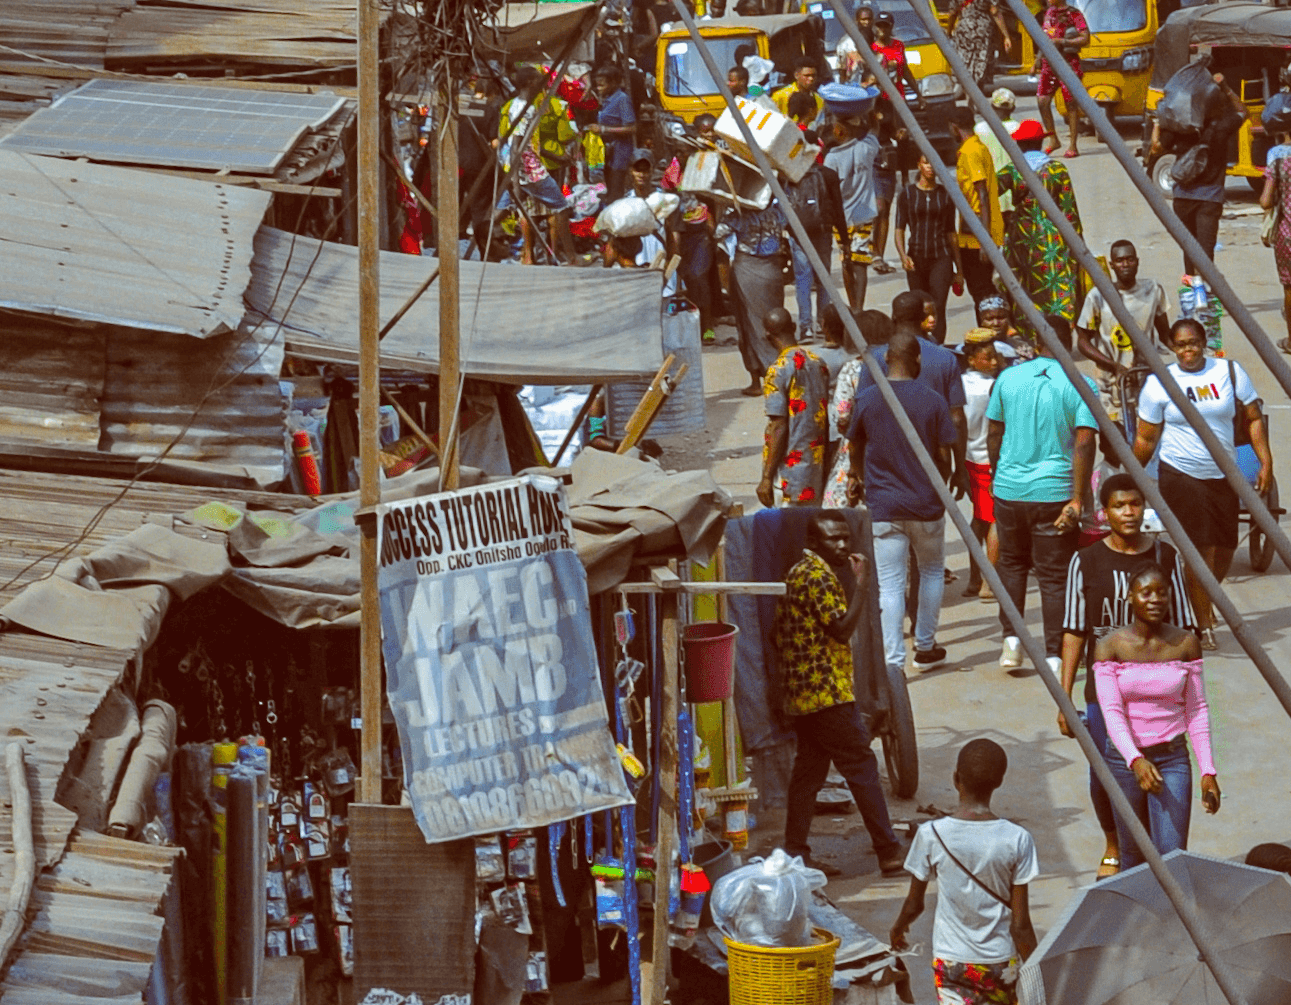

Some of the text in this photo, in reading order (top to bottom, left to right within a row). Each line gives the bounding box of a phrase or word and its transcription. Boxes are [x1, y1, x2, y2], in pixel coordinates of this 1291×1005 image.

[440, 486, 528, 550] TUTORIAL
[448, 553, 473, 570] CKC
[476, 546, 521, 565] Onitsha
[389, 561, 558, 652] WAEC
[404, 633, 567, 727] JAMB
[424, 708, 536, 758] LECTURES
[412, 751, 519, 796] COMPUTER
